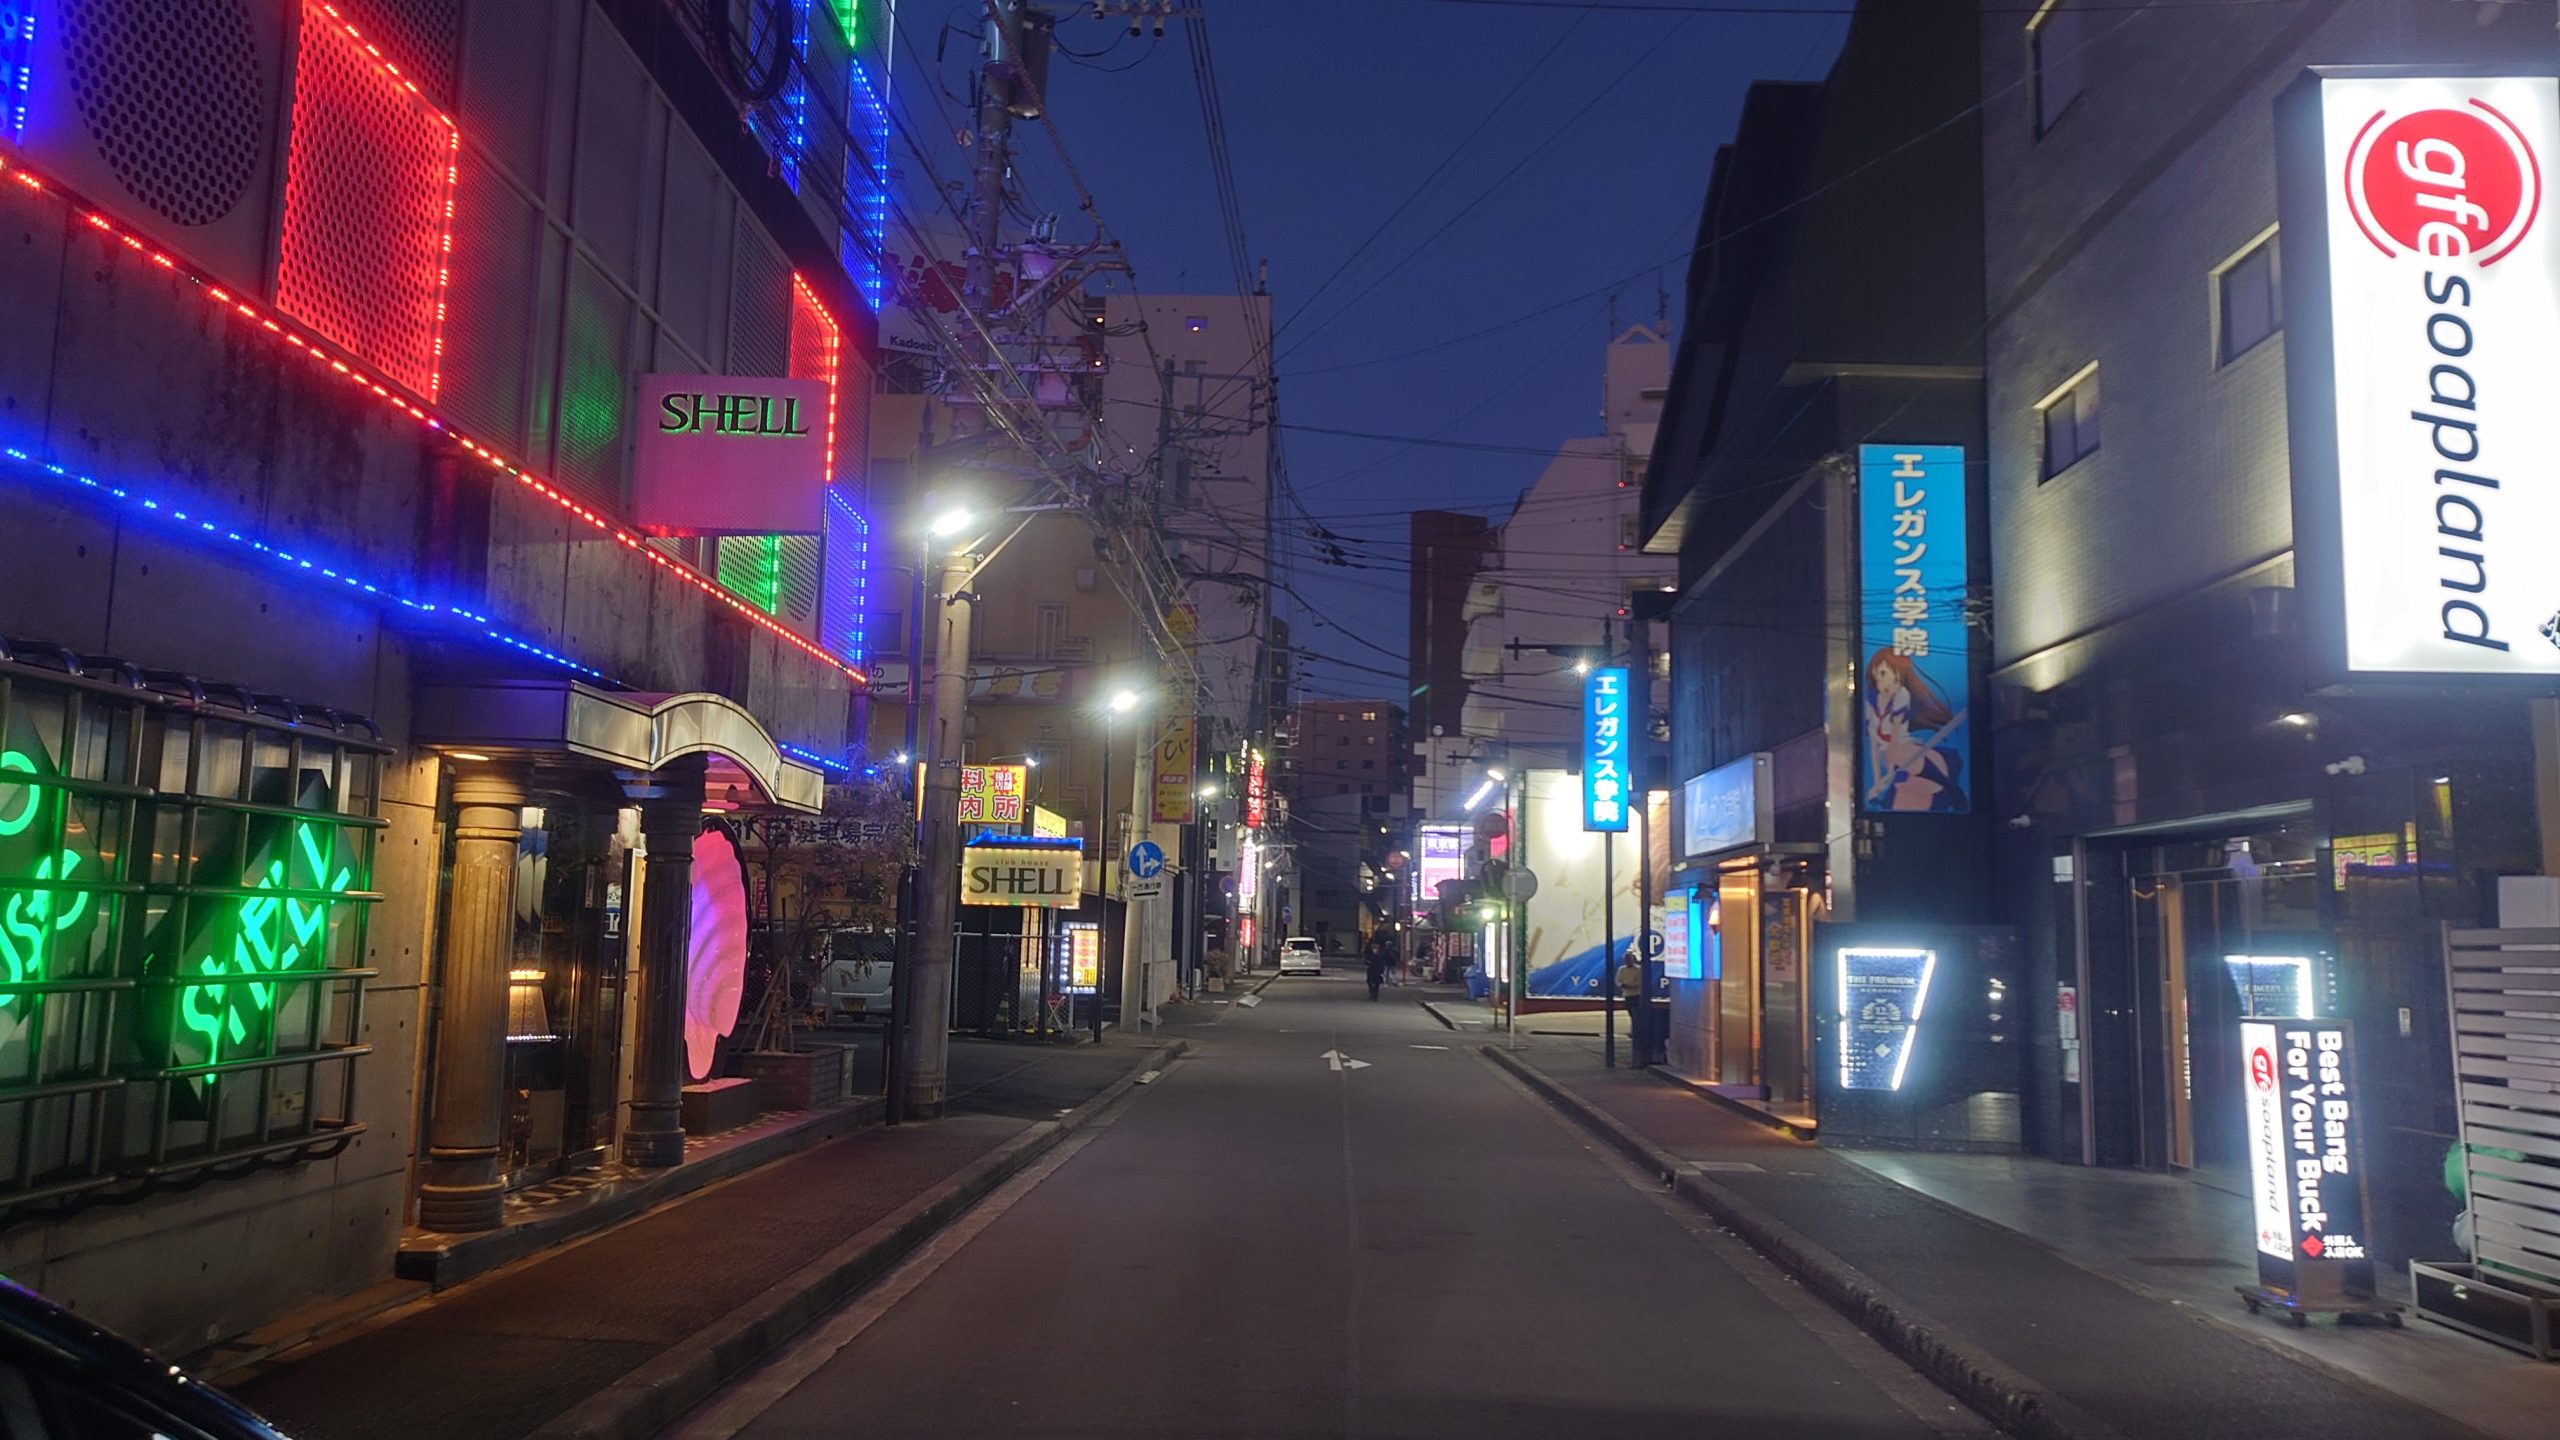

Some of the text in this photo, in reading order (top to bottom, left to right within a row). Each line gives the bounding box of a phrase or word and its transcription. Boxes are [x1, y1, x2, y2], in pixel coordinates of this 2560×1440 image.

[659, 393, 810, 435] SHELL
[2396, 138, 2510, 652] gfe soapland
[1891, 453, 1929, 657] エレガンス学院
[969, 866, 1073, 895] SHELL
[2261, 1097, 2281, 1213] soapland
[2285, 1031, 2328, 1232] For Your Buck
[2317, 1031, 2349, 1174] Best Bang
